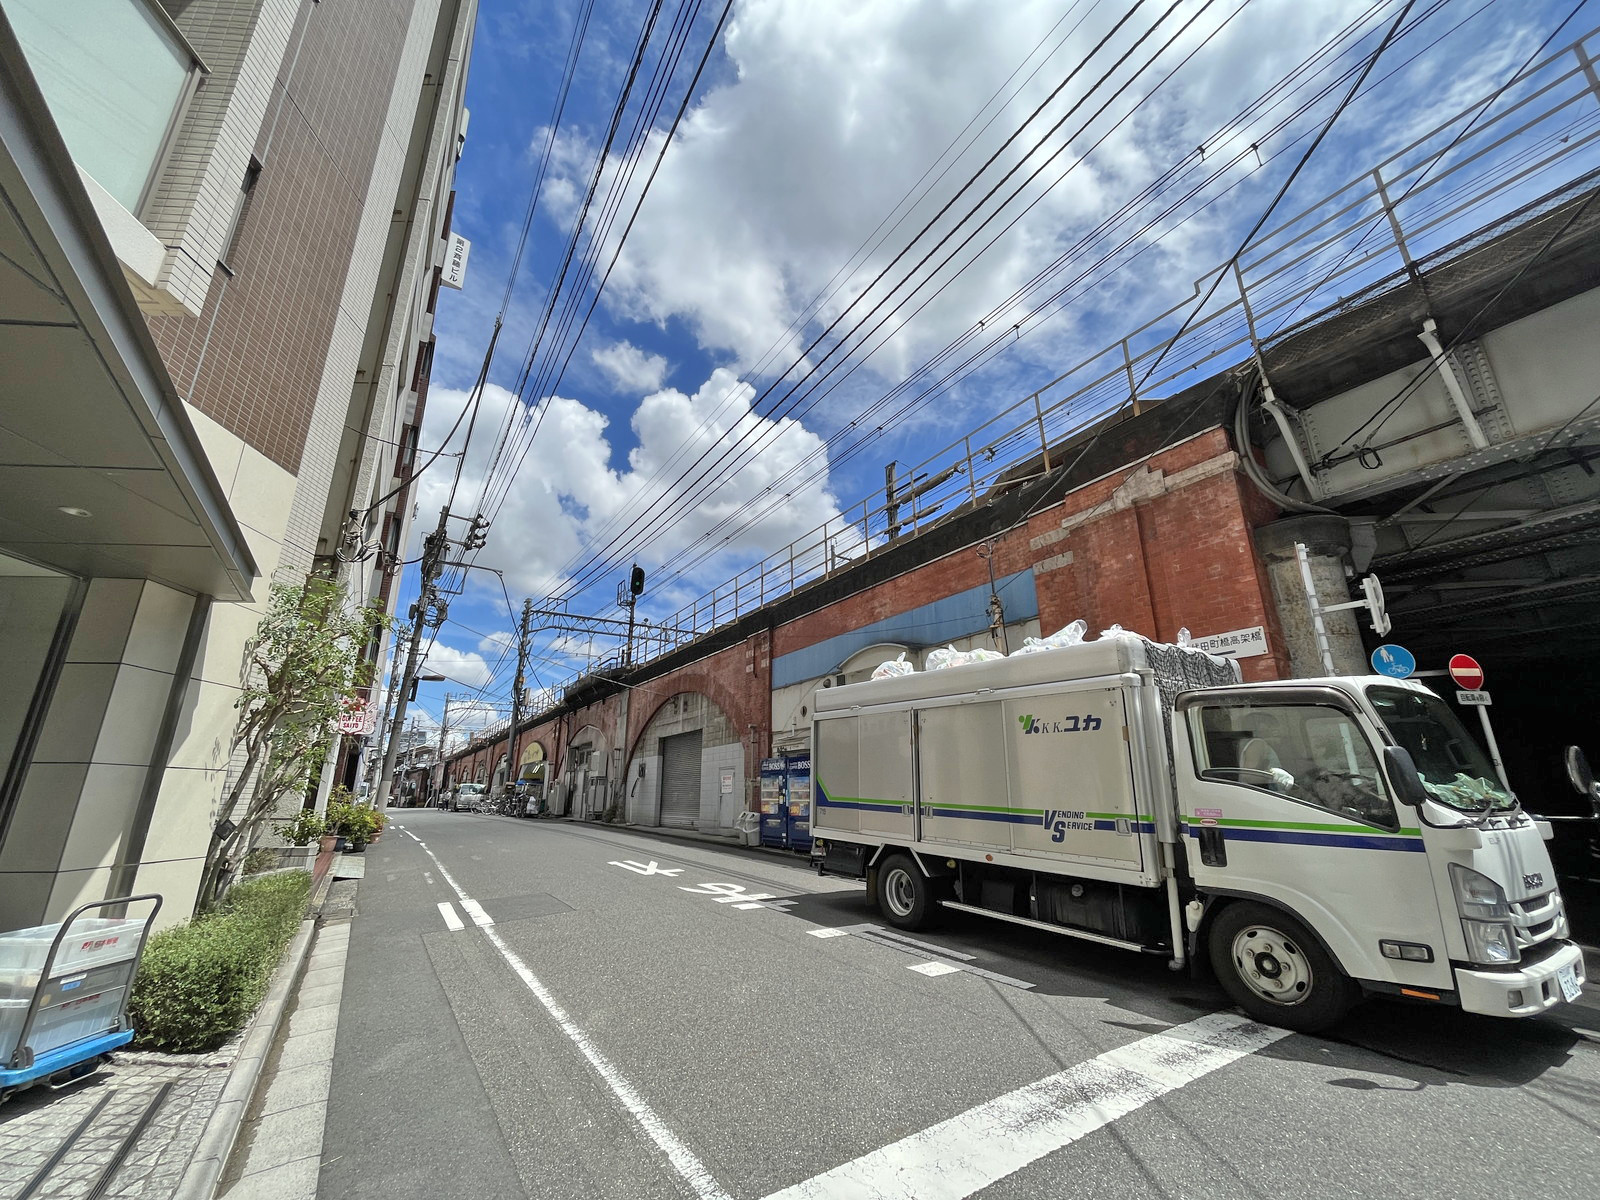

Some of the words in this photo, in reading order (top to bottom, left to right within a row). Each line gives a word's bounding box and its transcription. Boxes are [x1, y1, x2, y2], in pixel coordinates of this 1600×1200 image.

[1186, 631, 1262, 651] 代田町橋高架橋
[1043, 809, 1085, 830] VENDING
[1051, 820, 1093, 843] SERVICE
